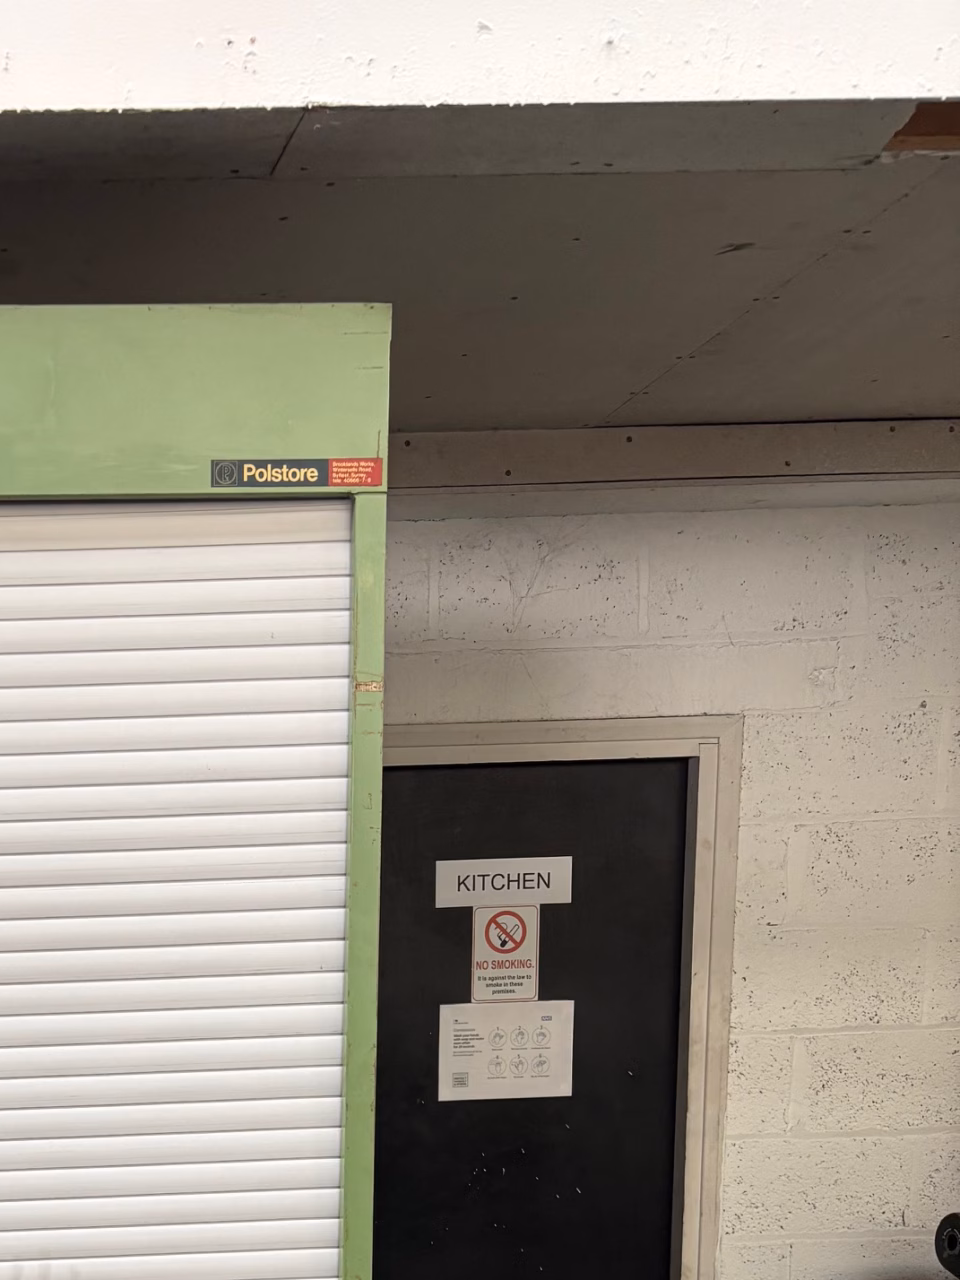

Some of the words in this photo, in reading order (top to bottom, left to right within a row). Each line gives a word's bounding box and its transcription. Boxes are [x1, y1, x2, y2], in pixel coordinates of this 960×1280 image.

[243, 463, 319, 482] Polstore
[457, 872, 551, 892] KITCHEN
[475, 960, 489, 970] NO
[491, 958, 535, 970] SMOKING.
[491, 988, 517, 996] premises.
